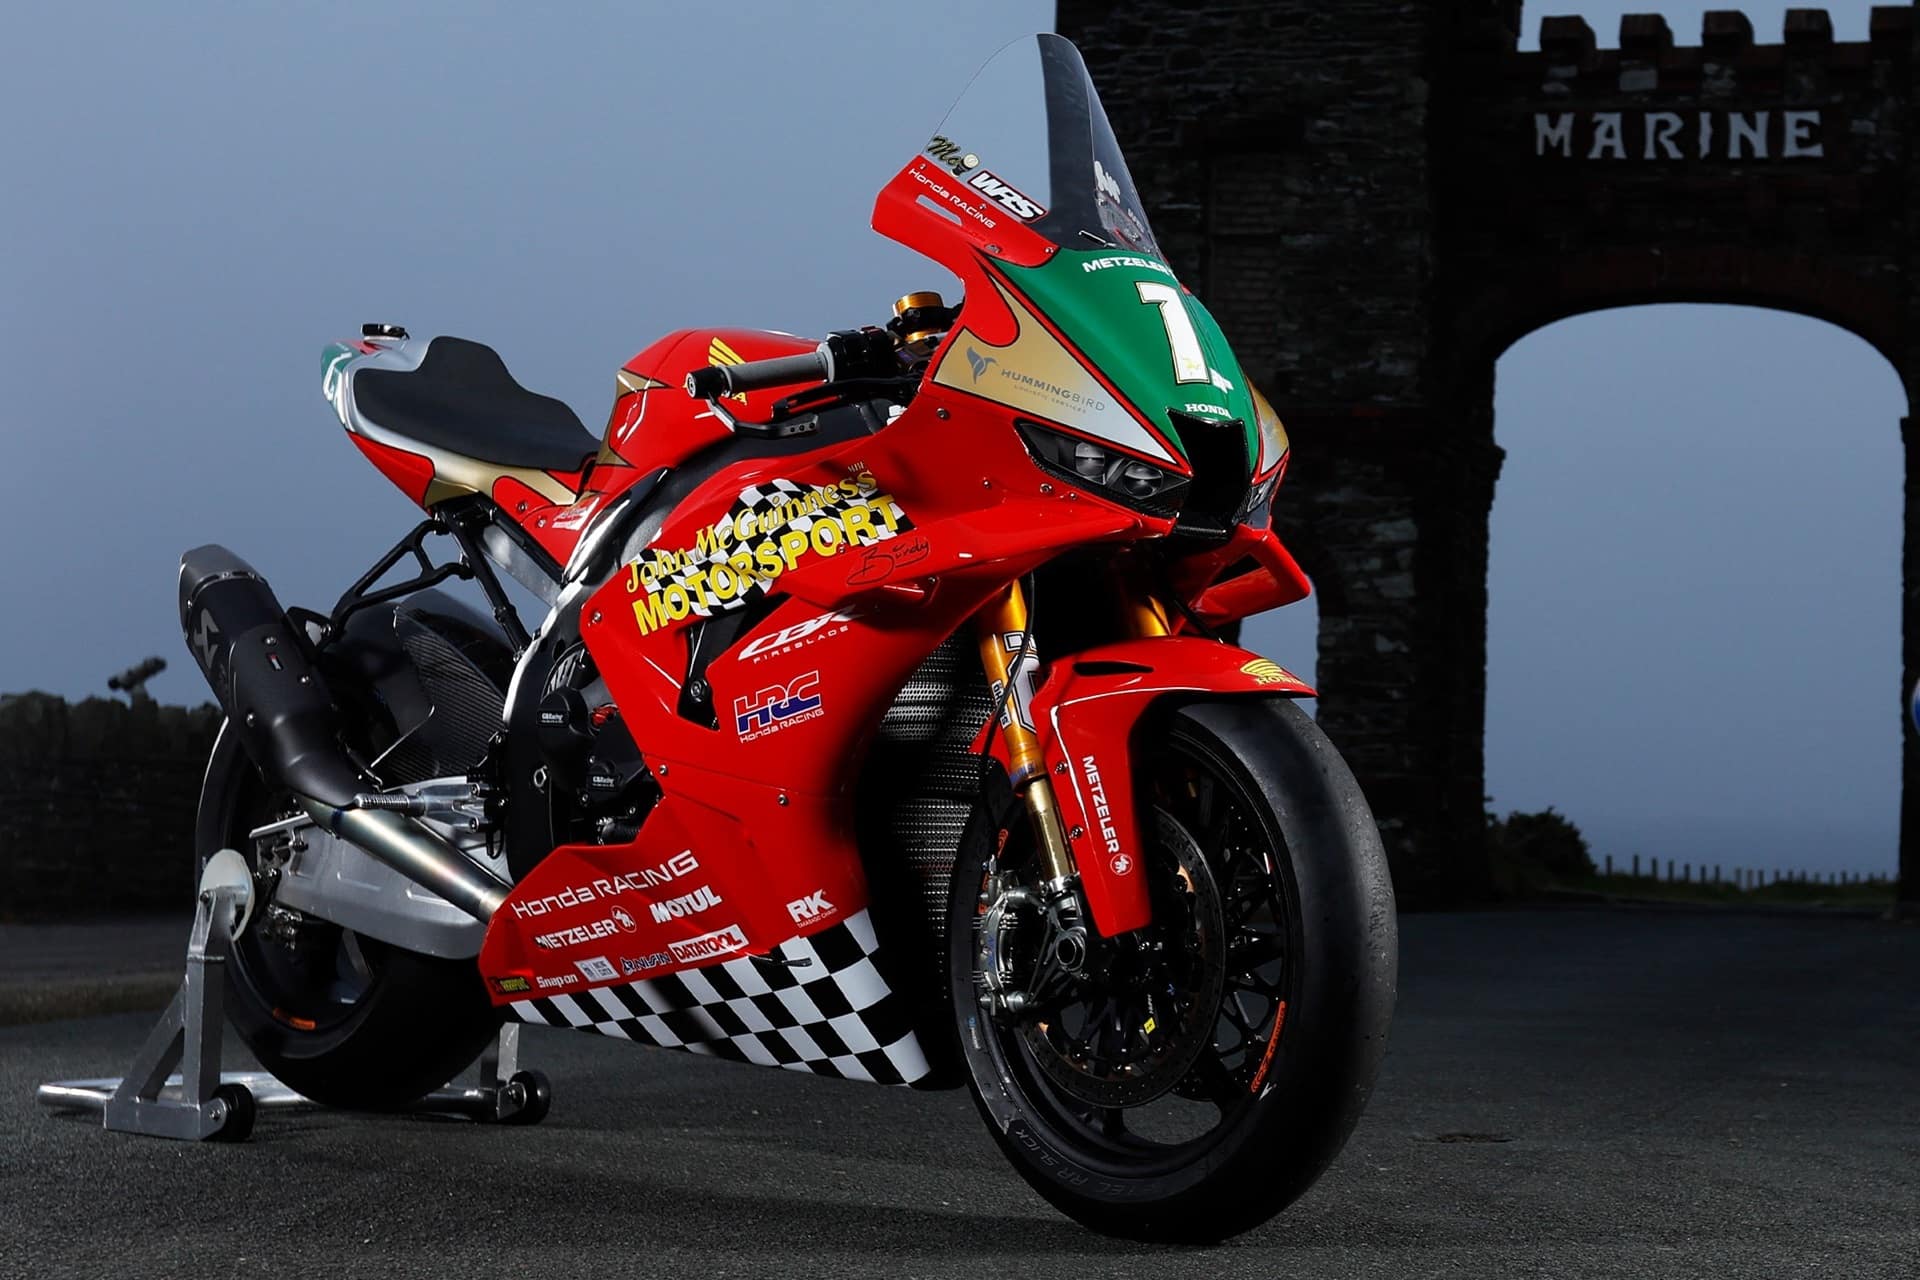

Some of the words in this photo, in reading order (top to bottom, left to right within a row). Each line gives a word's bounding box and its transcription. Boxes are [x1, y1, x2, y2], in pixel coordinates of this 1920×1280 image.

[1534, 111, 1824, 159] MARINE
[908, 168, 950, 199] Honda
[949, 195, 997, 229] RACING
[969, 171, 1045, 218] WRS
[1135, 280, 1212, 386] 1
[1000, 368, 1106, 412] HUMMINGBIRD
[1184, 403, 1233, 419] HONDA
[626, 547, 694, 593] John
[694, 470, 879, 562] McGuinness
[631, 494, 899, 636] MOTORSPORT
[737, 604, 865, 662] CBR
[753, 625, 849, 665] FIREBLADE
[734, 669, 822, 736] HRC
[739, 725, 780, 744] Honda
[779, 707, 825, 731] RACING
[1082, 755, 1121, 854] METZELER
[510, 886, 597, 920] Honda
[592, 849, 700, 899] RACING
[649, 885, 723, 924] MOTUL
[785, 889, 835, 924] RK
[534, 918, 620, 950] METZELER
[673, 931, 743, 959] DATATOOL
[535, 973, 579, 989] Snap-on
